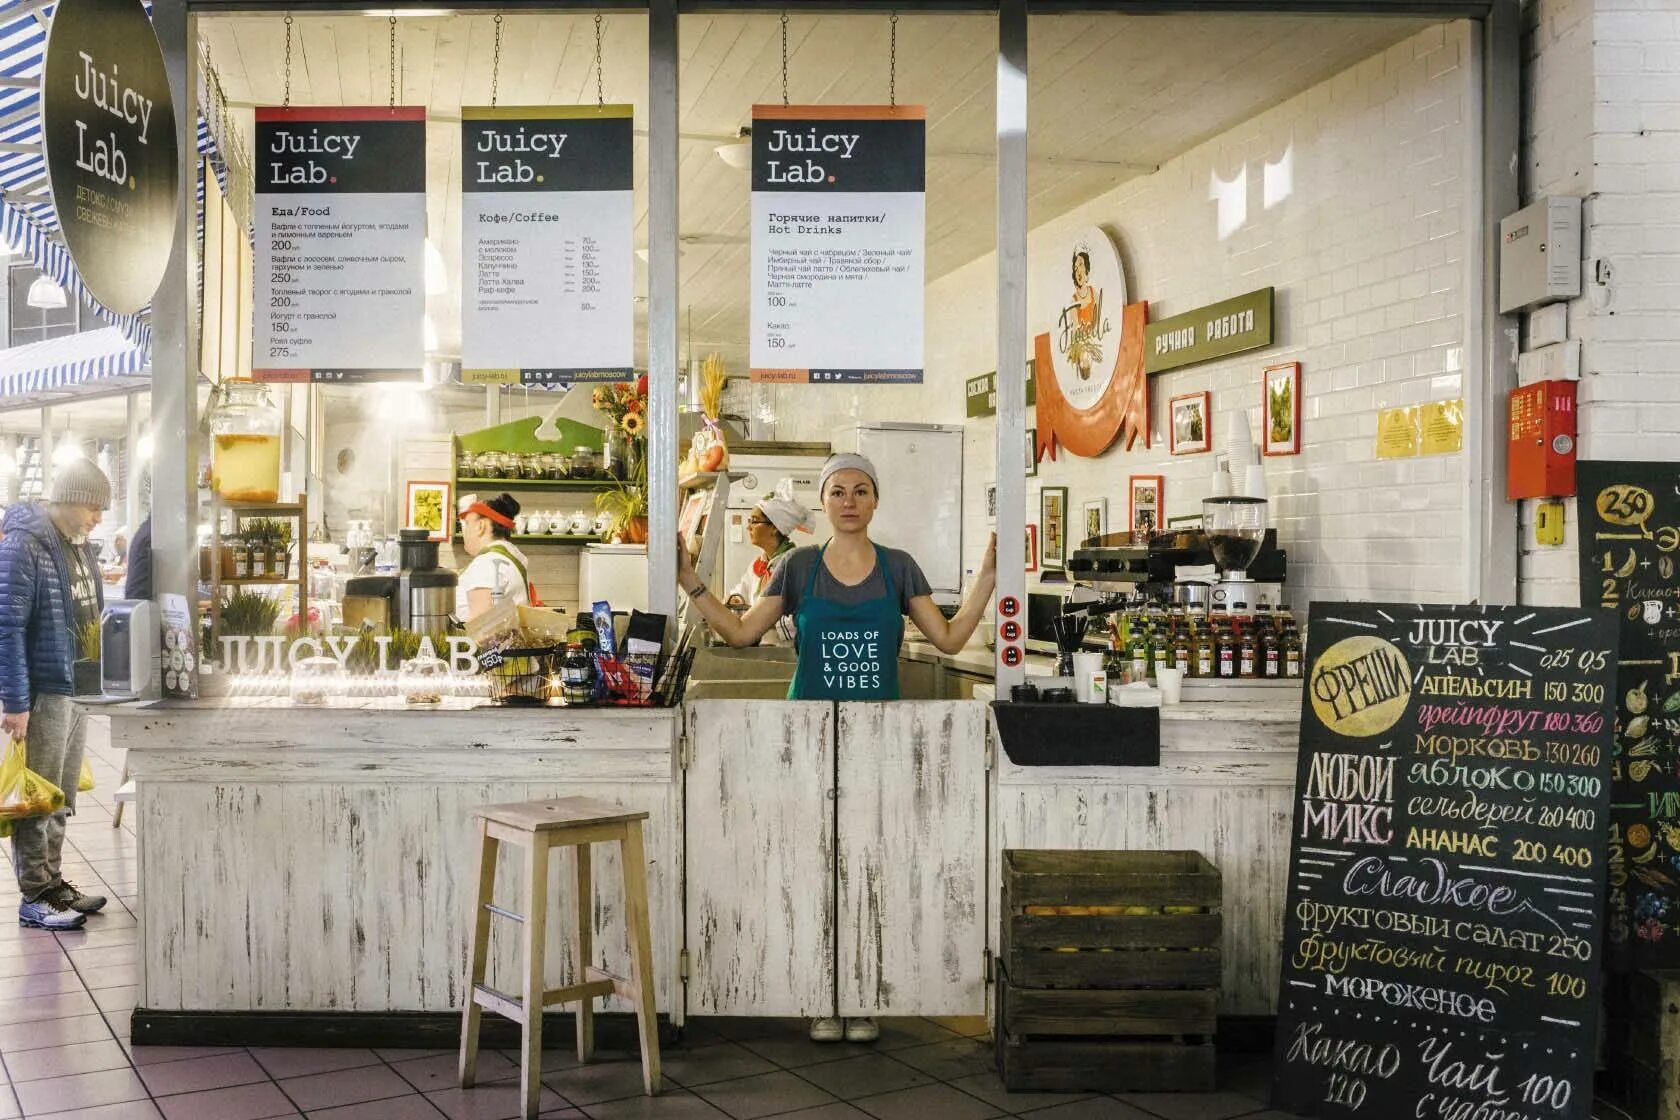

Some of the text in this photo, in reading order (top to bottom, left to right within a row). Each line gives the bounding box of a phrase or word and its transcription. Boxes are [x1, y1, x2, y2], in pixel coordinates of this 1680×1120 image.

[75, 50, 152, 144] Juicy
[271, 128, 360, 159] Juicy
[477, 127, 568, 157] Juicy
[768, 128, 860, 159] Juicy
[769, 213, 820, 224] Горячие
[769, 225, 842, 234] Hot Drinks
[271, 240, 292, 251] 200
[270, 273, 291, 283] 250
[270, 297, 291, 307] 200
[768, 297, 786, 307] 100
[271, 322, 290, 332] 150
[768, 322, 790, 330] Какао
[1154, 309, 1255, 356] РУЧНАЯ РАБОТА
[270, 347, 289, 357] 275
[768, 338, 785, 348] 150
[1604, 490, 1647, 520] 250
[1601, 577, 1620, 599] 2
[821, 631, 880, 640] LOADS OF
[1408, 618, 1505, 647] JUICY
[215, 635, 481, 677] JUICY LAB
[822, 643, 878, 659] LOVE
[1428, 645, 1480, 667] LAB
[823, 662, 880, 672] & GOOD
[823, 675, 880, 689] VIBES
[1313, 646, 1411, 722] ФРЕШИ
[1419, 675, 1605, 704] АПЕЛЬСИН 150 300
[1544, 711, 1571, 733] 180
[1570, 710, 1605, 734] 360
[1545, 741, 1570, 764] 130
[1571, 742, 1601, 767] 260
[1302, 741, 1397, 803] ЛЮБОЙ
[1407, 758, 1602, 799] яблоко 150 300
[1300, 799, 1395, 846] МИКС
[1407, 789, 1538, 830] сельдерей
[1564, 805, 1596, 831] 400
[1405, 825, 1593, 868] АНАНАС 200 400
[1608, 844, 1625, 863] 2
[1342, 856, 1521, 915] Сладкое
[1455, 921, 1545, 953] салат
[1546, 935, 1592, 961] 250
[1455, 956, 1536, 997] пирог
[1545, 971, 1586, 999] 100
[1286, 1021, 1401, 1079] Какао
[1417, 1037, 1573, 1110] Чай 100
[1415, 1093, 1435, 1119] с
